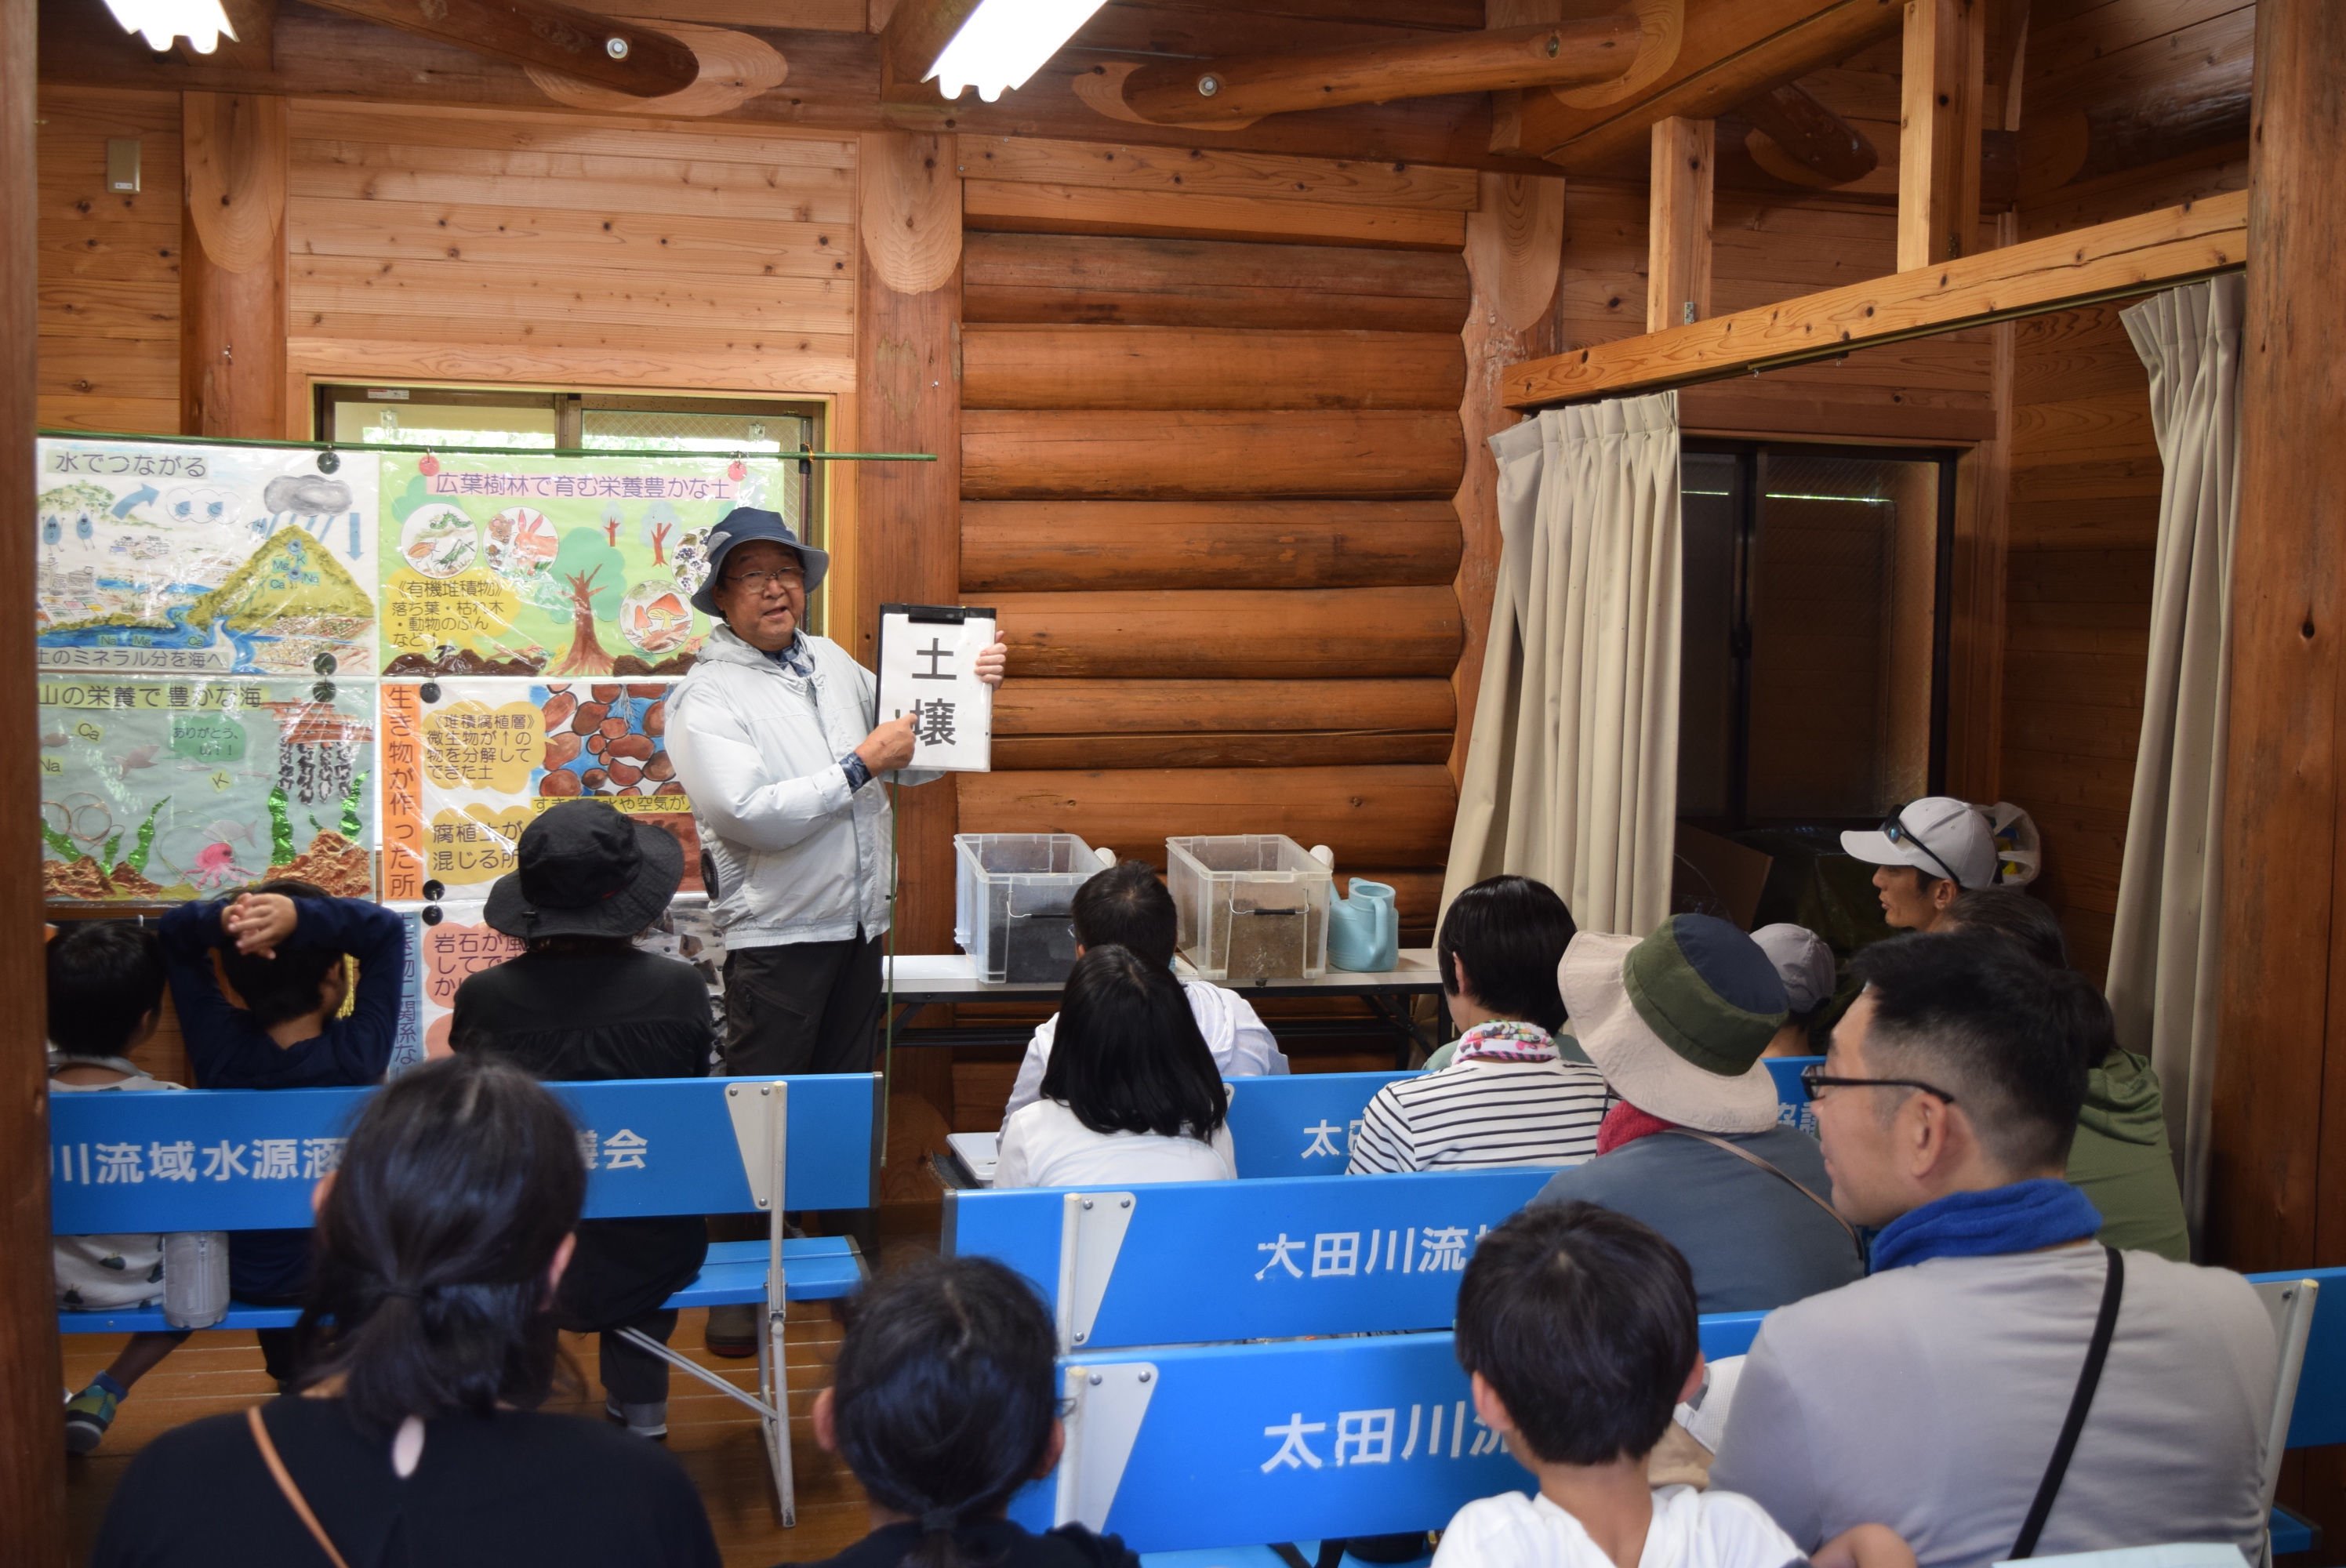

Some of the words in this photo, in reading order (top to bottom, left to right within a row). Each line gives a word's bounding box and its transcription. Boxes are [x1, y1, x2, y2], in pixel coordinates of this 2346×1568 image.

[56, 452, 207, 477] 水でつながる
[436, 473, 732, 499] 広葉樹林で育む栄養豊かな土
[273, 560, 290, 571] Mg
[296, 555, 306, 564] K
[270, 579, 285, 590] Ca
[304, 573, 319, 583] Na
[173, 612, 184, 622] K
[100, 636, 117, 646] Na
[133, 636, 151, 648] Mg
[188, 636, 203, 648] Ca
[38, 649, 223, 669] 土のミネラル分を海へ
[910, 637, 957, 746] 土壌
[78, 722, 100, 742] Ca
[427, 747, 531, 764] 物を分解して
[427, 764, 494, 780] できた土
[212, 773, 230, 789] K
[388, 685, 416, 898] 生き物が作った所
